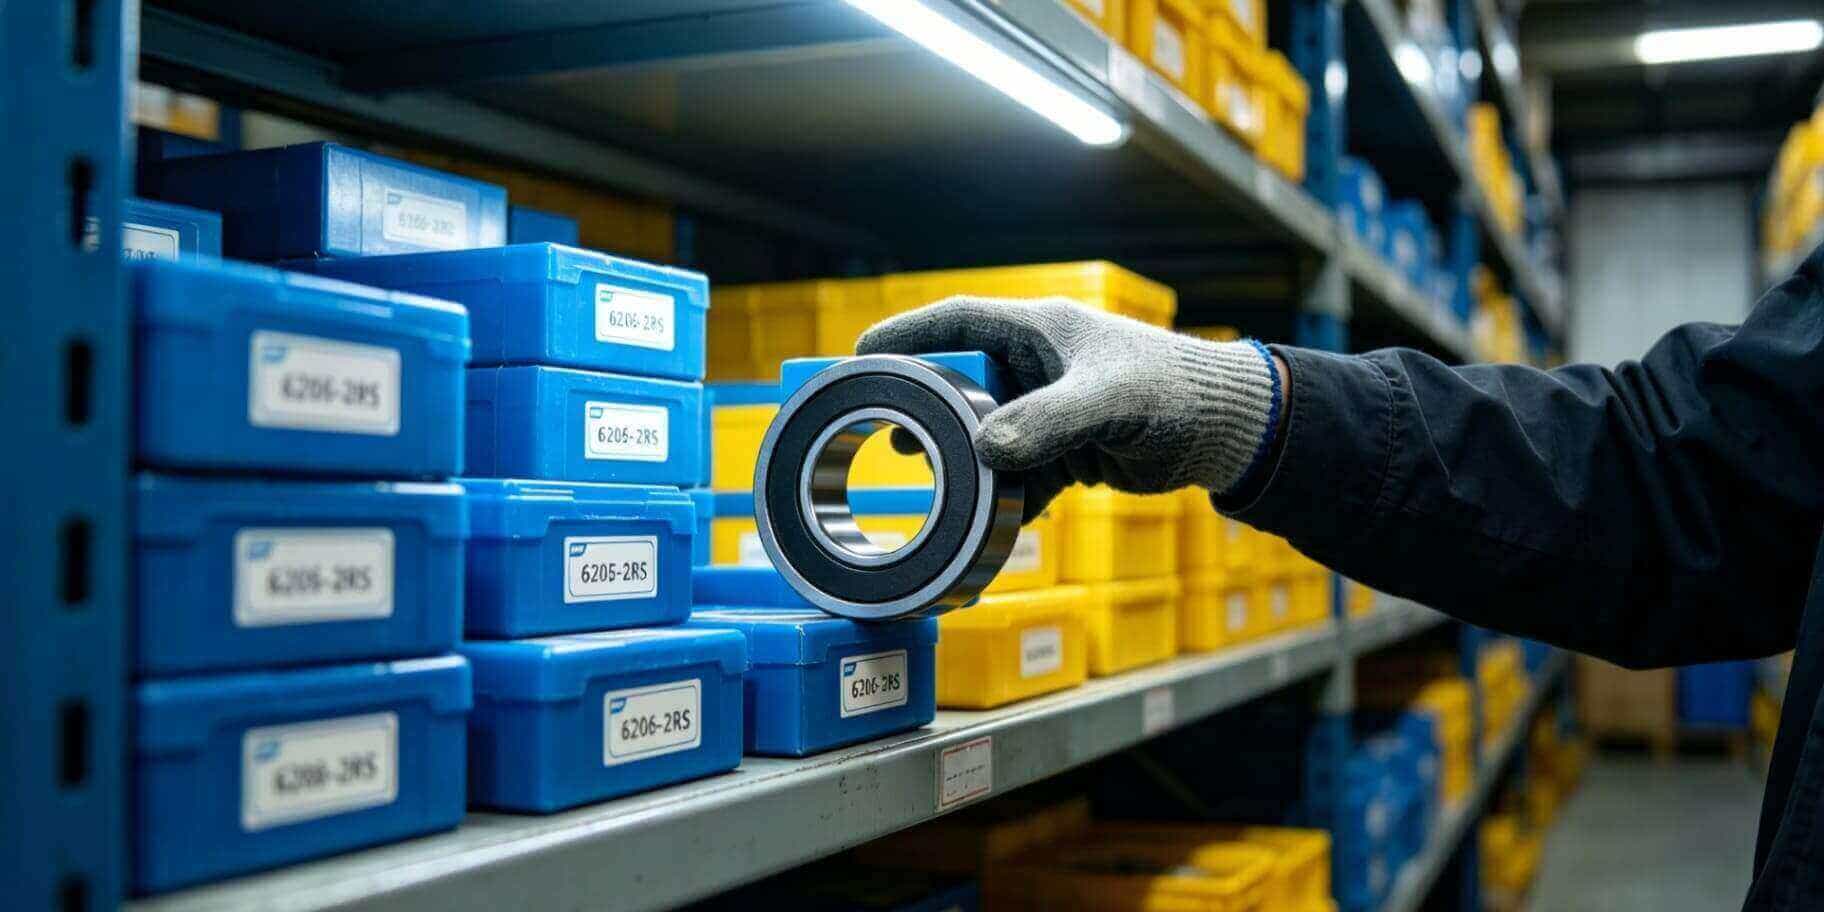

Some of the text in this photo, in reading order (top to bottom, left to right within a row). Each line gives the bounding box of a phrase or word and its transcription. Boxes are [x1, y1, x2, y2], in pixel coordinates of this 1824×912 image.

[581, 562, 647, 583] 6205-2RS
[852, 673, 900, 698] 6206-2RS
[622, 709, 690, 740] 6206-2RS
